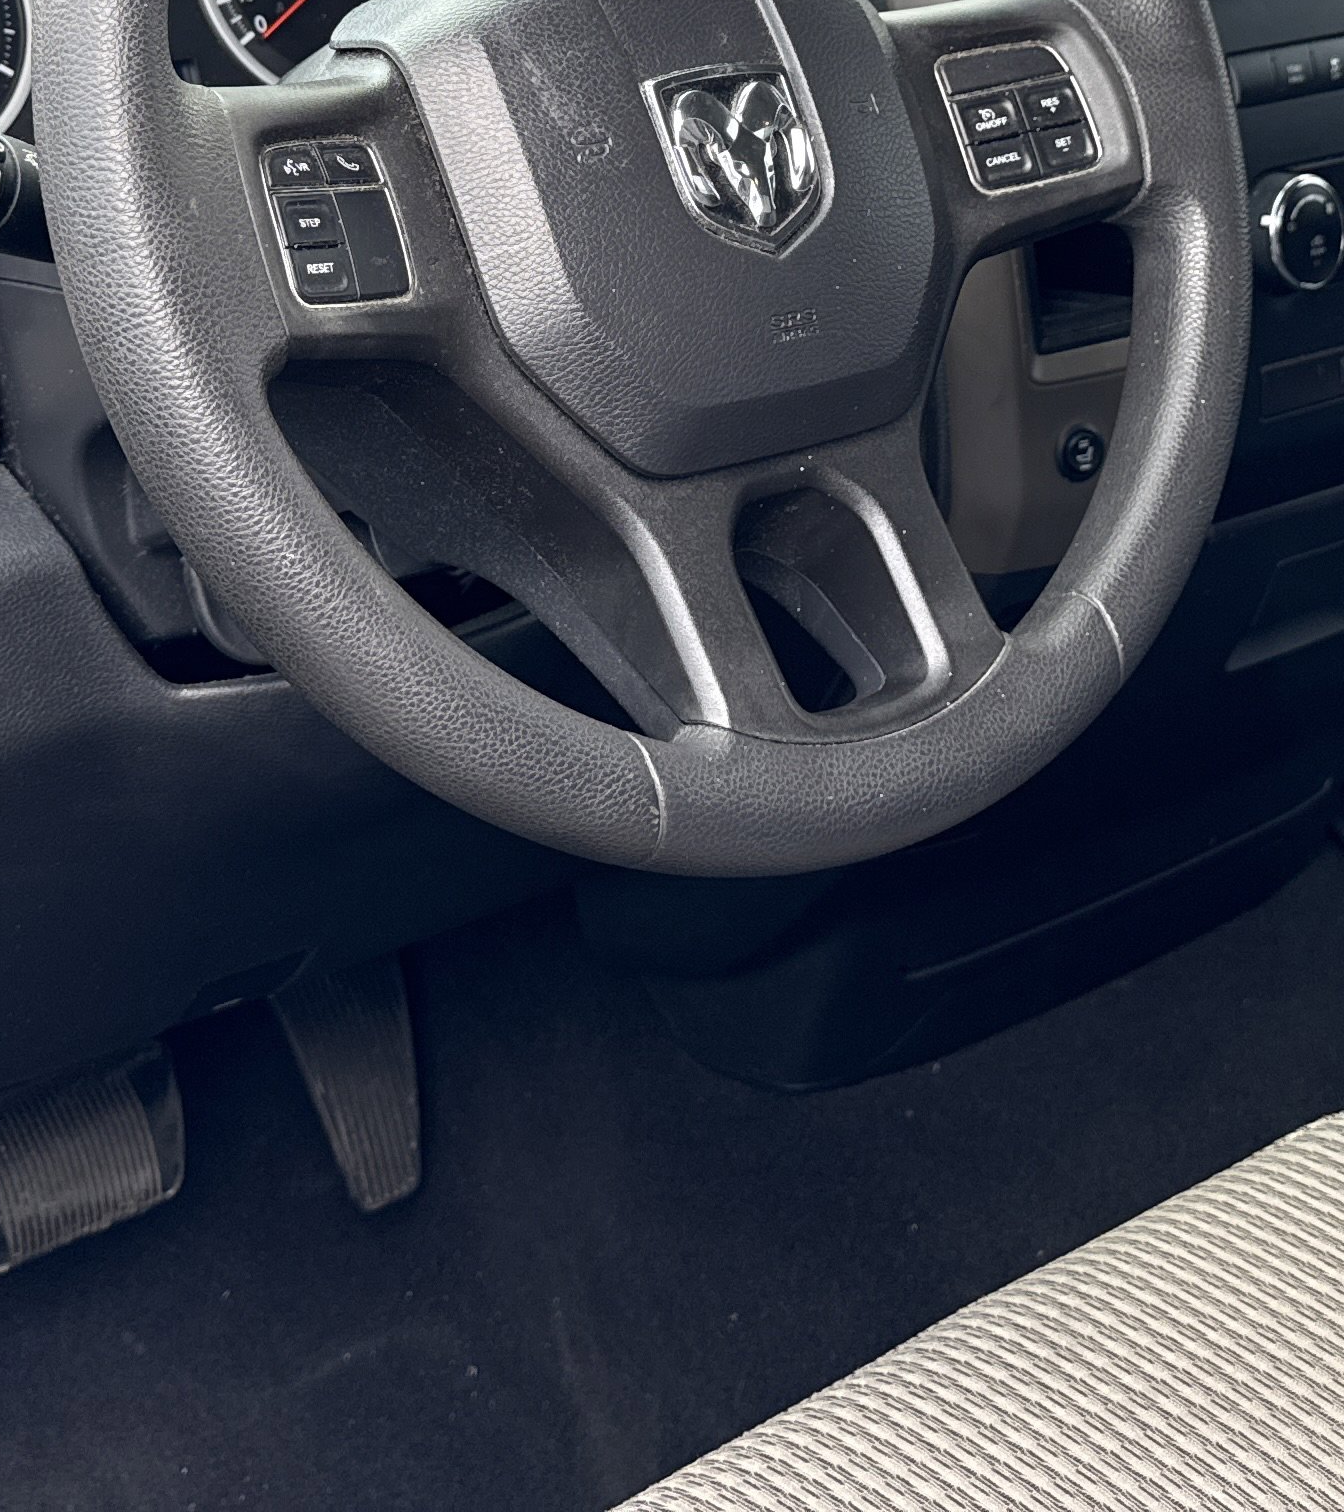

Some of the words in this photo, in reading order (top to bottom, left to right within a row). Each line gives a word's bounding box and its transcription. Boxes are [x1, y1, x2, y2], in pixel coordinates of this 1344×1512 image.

[254, 15, 268, 33] 0
[1041, 96, 1060, 108] RES
[975, 116, 1008, 132] ON/OFF
[1055, 136, 1072, 148] SET
[985, 152, 1022, 167] CANCEL
[298, 218, 321, 228] STEP
[307, 262, 334, 274] RESET
[770, 307, 817, 327] SRS
